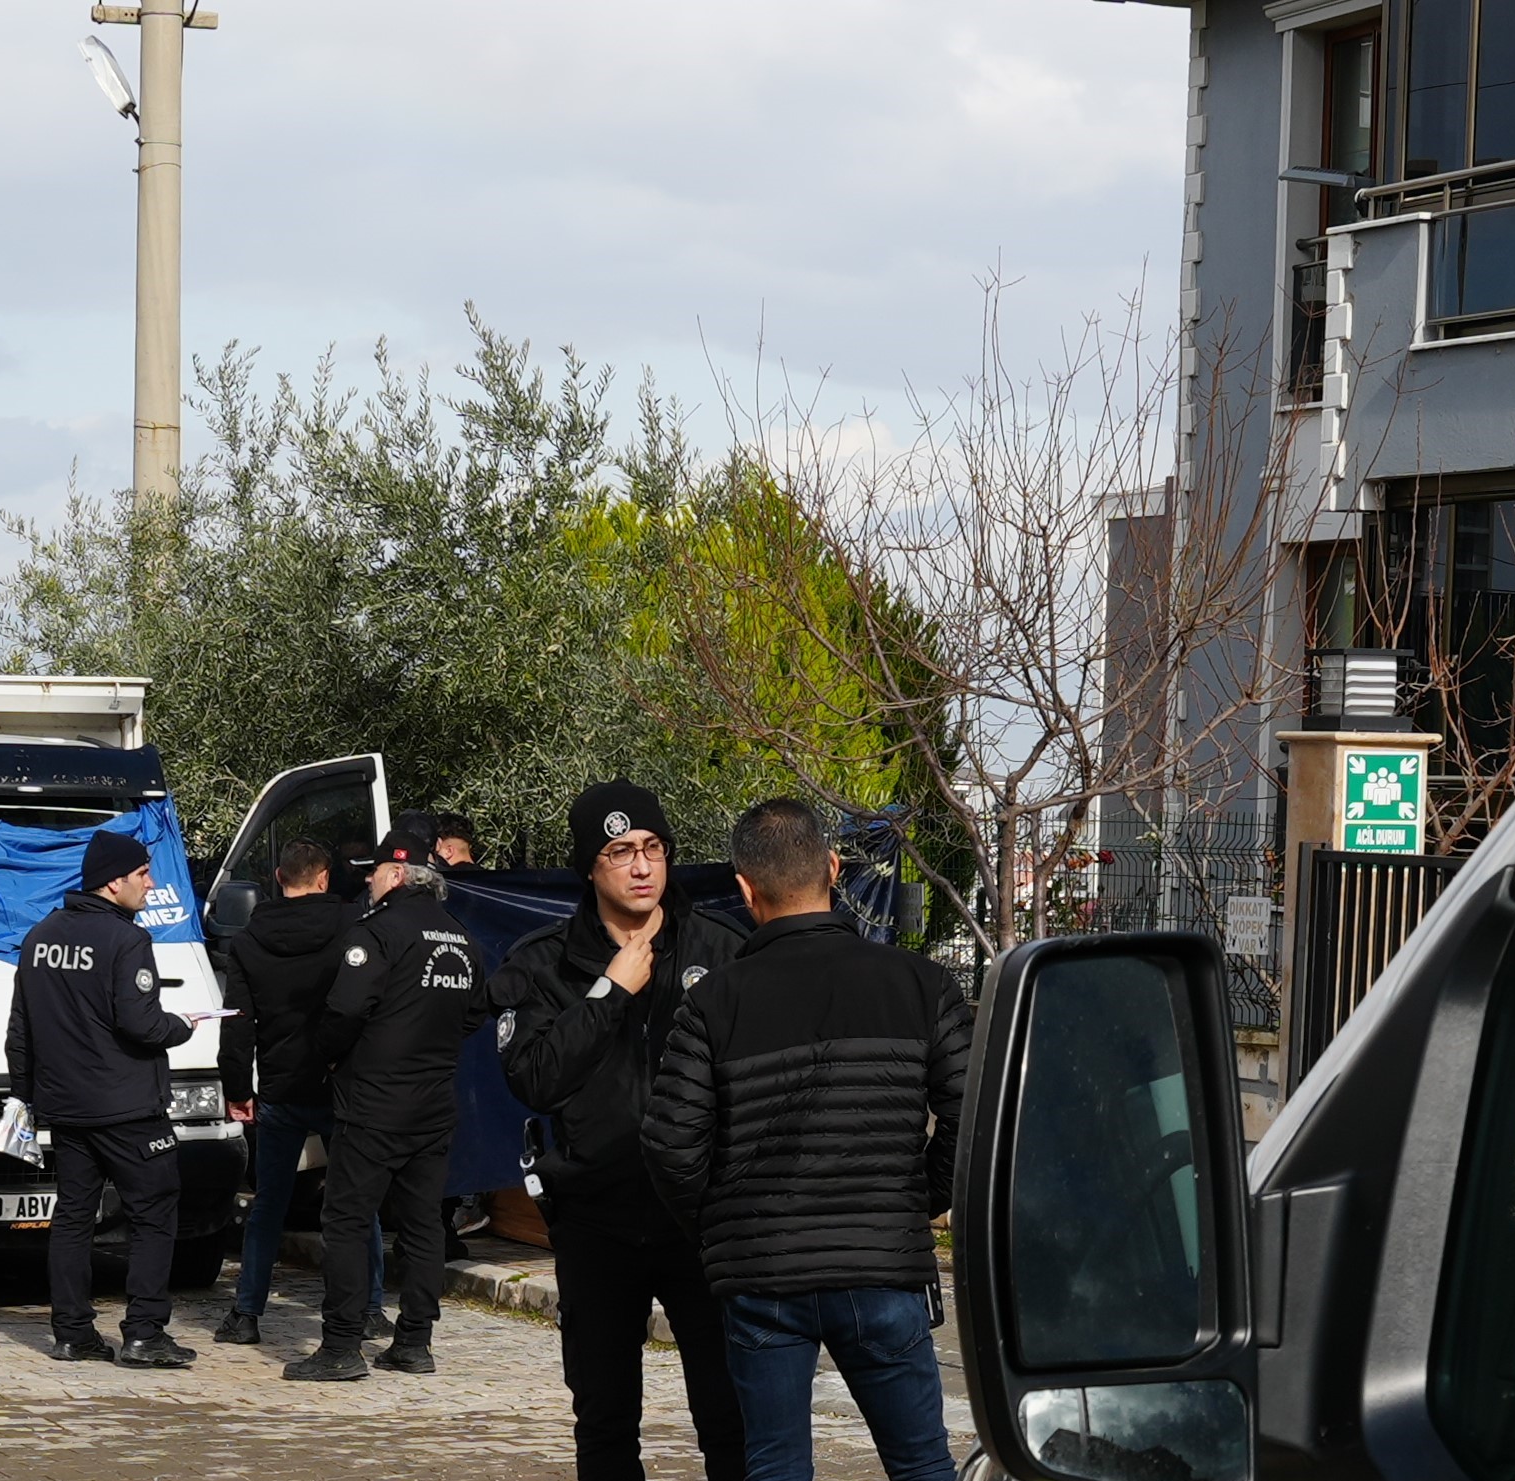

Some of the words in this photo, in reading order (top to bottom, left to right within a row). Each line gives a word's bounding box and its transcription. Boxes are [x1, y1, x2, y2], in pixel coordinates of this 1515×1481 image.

[1355, 825, 1375, 846] ACİL
[1376, 829, 1406, 845] DURUM
[145, 883, 180, 906] ERİ
[1232, 917, 1263, 935] KÖPEK
[1238, 938, 1257, 953] VAR
[16, 1196, 51, 1218] ABV
